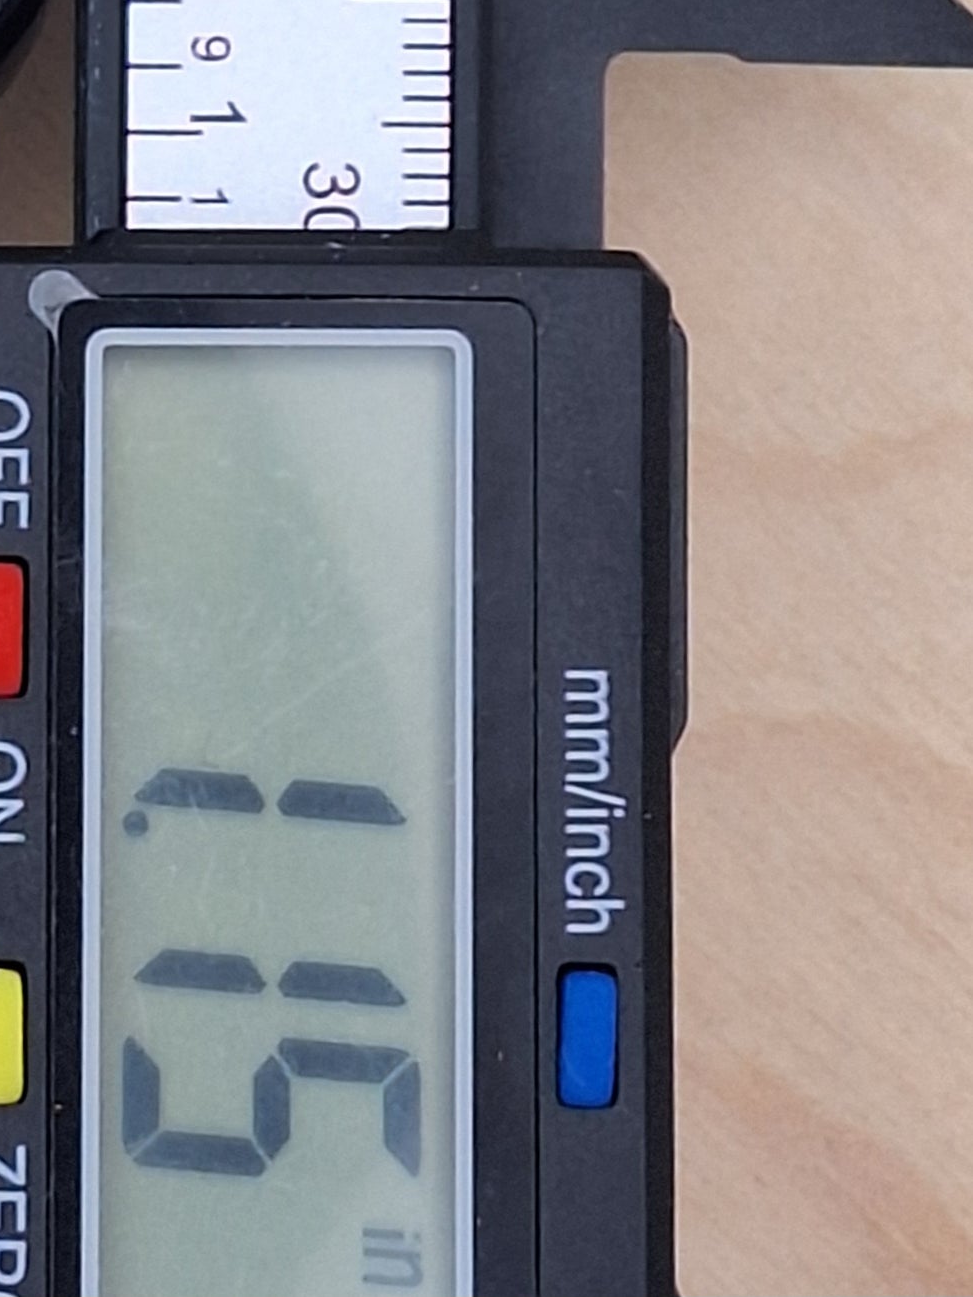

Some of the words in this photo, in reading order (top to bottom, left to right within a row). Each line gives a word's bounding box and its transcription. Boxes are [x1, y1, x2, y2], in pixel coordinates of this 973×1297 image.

[189, 101, 247, 123] 1
[190, 35, 232, 62] 9
[564, 669, 626, 933] mm/inch
[121, 767, 422, 1179] 1.15
[361, 1227, 424, 1288] in
